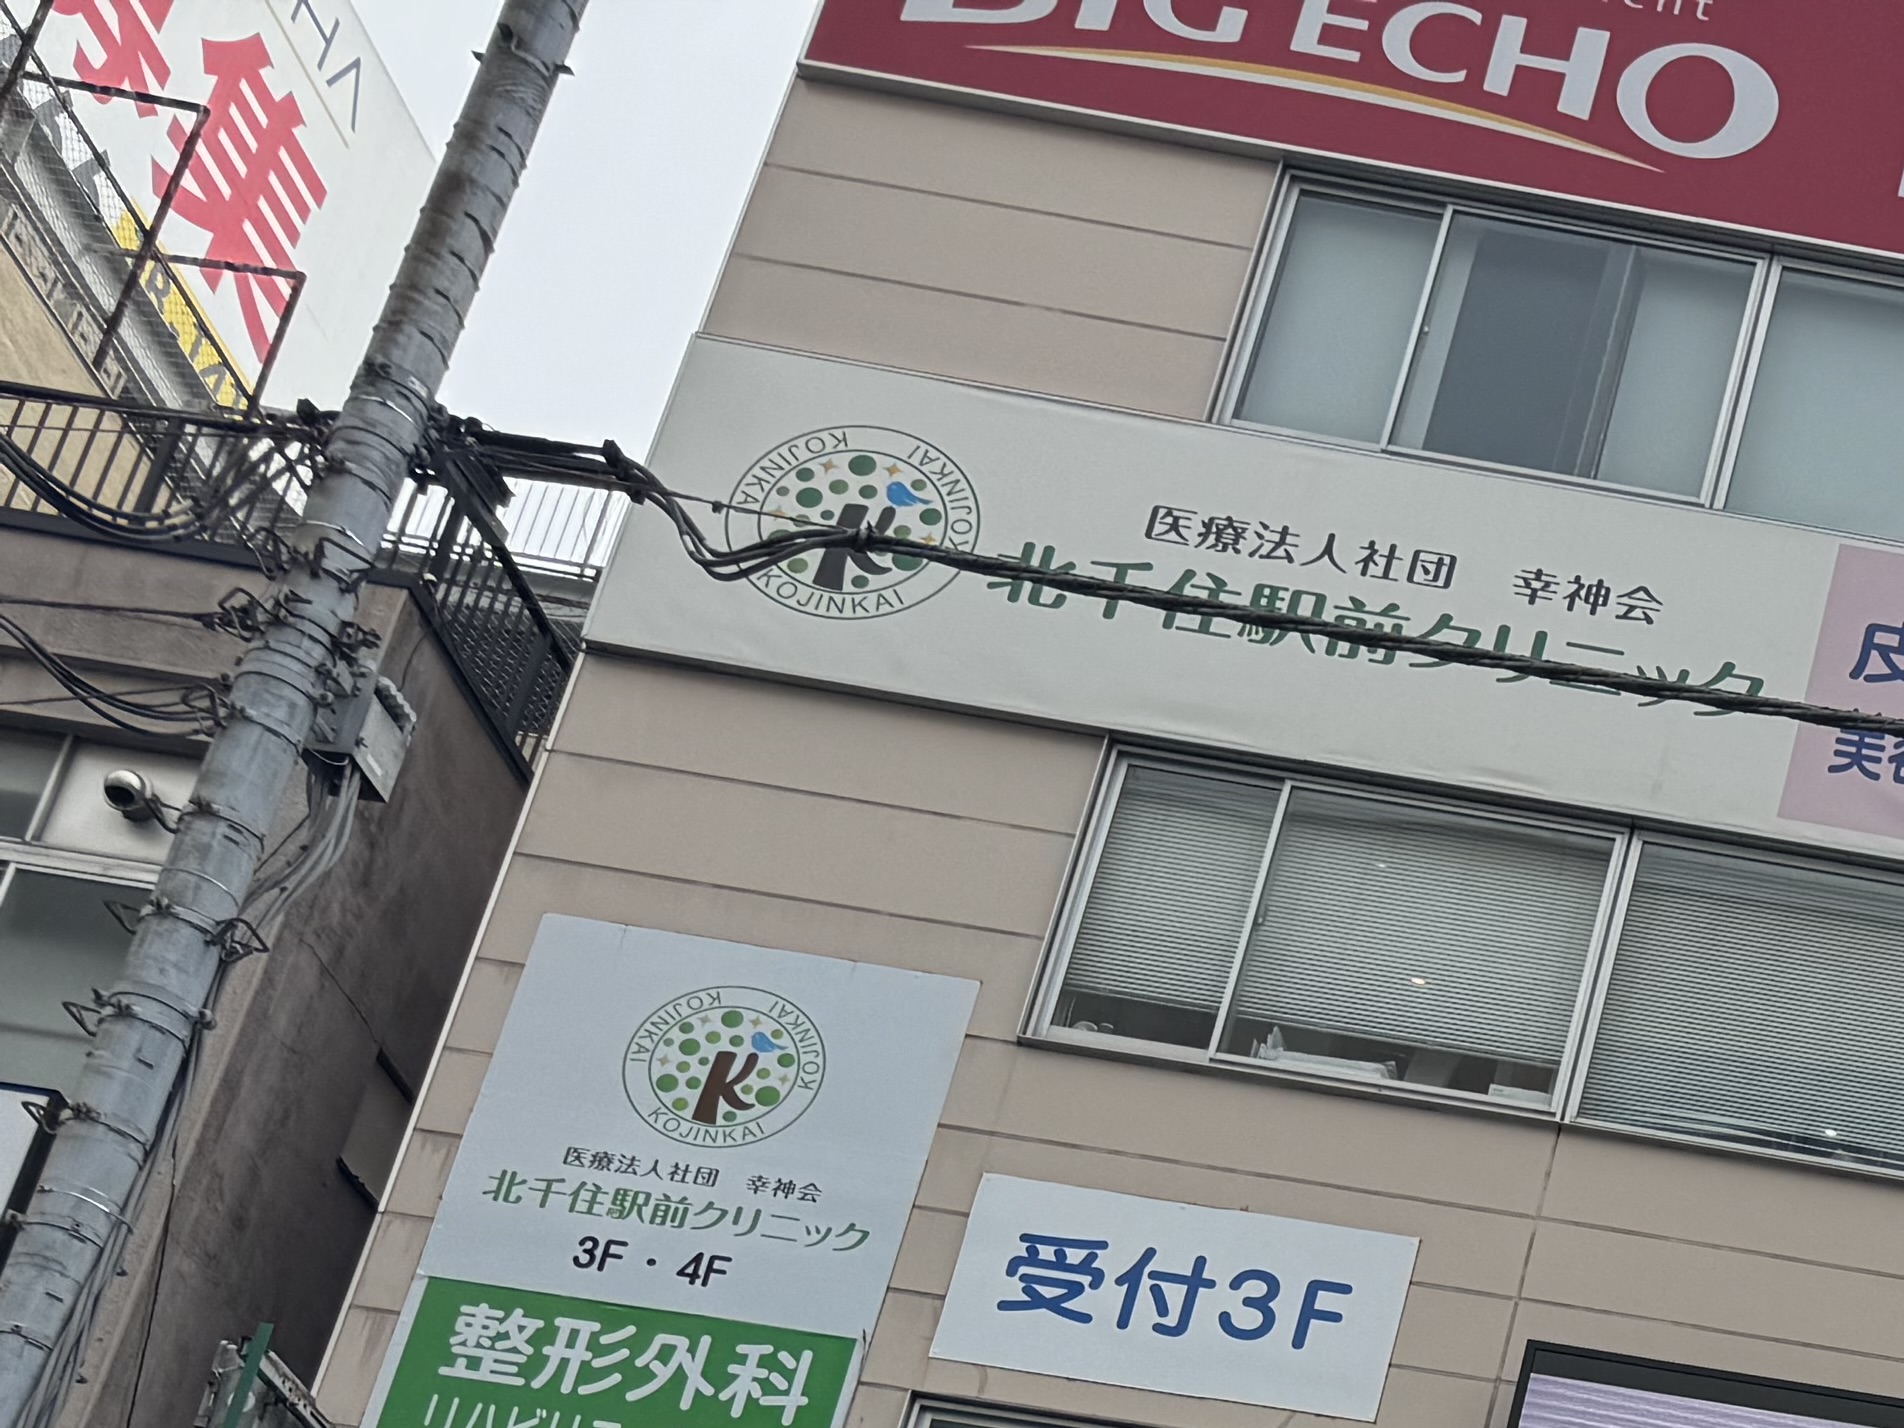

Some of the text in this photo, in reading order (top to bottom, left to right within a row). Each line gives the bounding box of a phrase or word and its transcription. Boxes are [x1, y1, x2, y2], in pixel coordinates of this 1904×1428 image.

[1289, 0, 1779, 159] ECHO
[736, 431, 849, 507] KOJINKA
[756, 568, 904, 615] KOJINKAI
[1145, 505, 1665, 627] 医療法人社団 幸神会
[988, 541, 1763, 717] 北千住駅前クリニック
[628, 988, 724, 1065] KOJINKAI
[768, 999, 821, 1092] KOJINKAI
[646, 1104, 767, 1145] KOJINKAI
[481, 1168, 872, 1253] 北千住駅前クリニック
[562, 1144, 824, 1204] 医療法人社団 幸神会
[997, 1232, 1354, 1350] 受付3F
[437, 1301, 815, 1428] 整形外科
